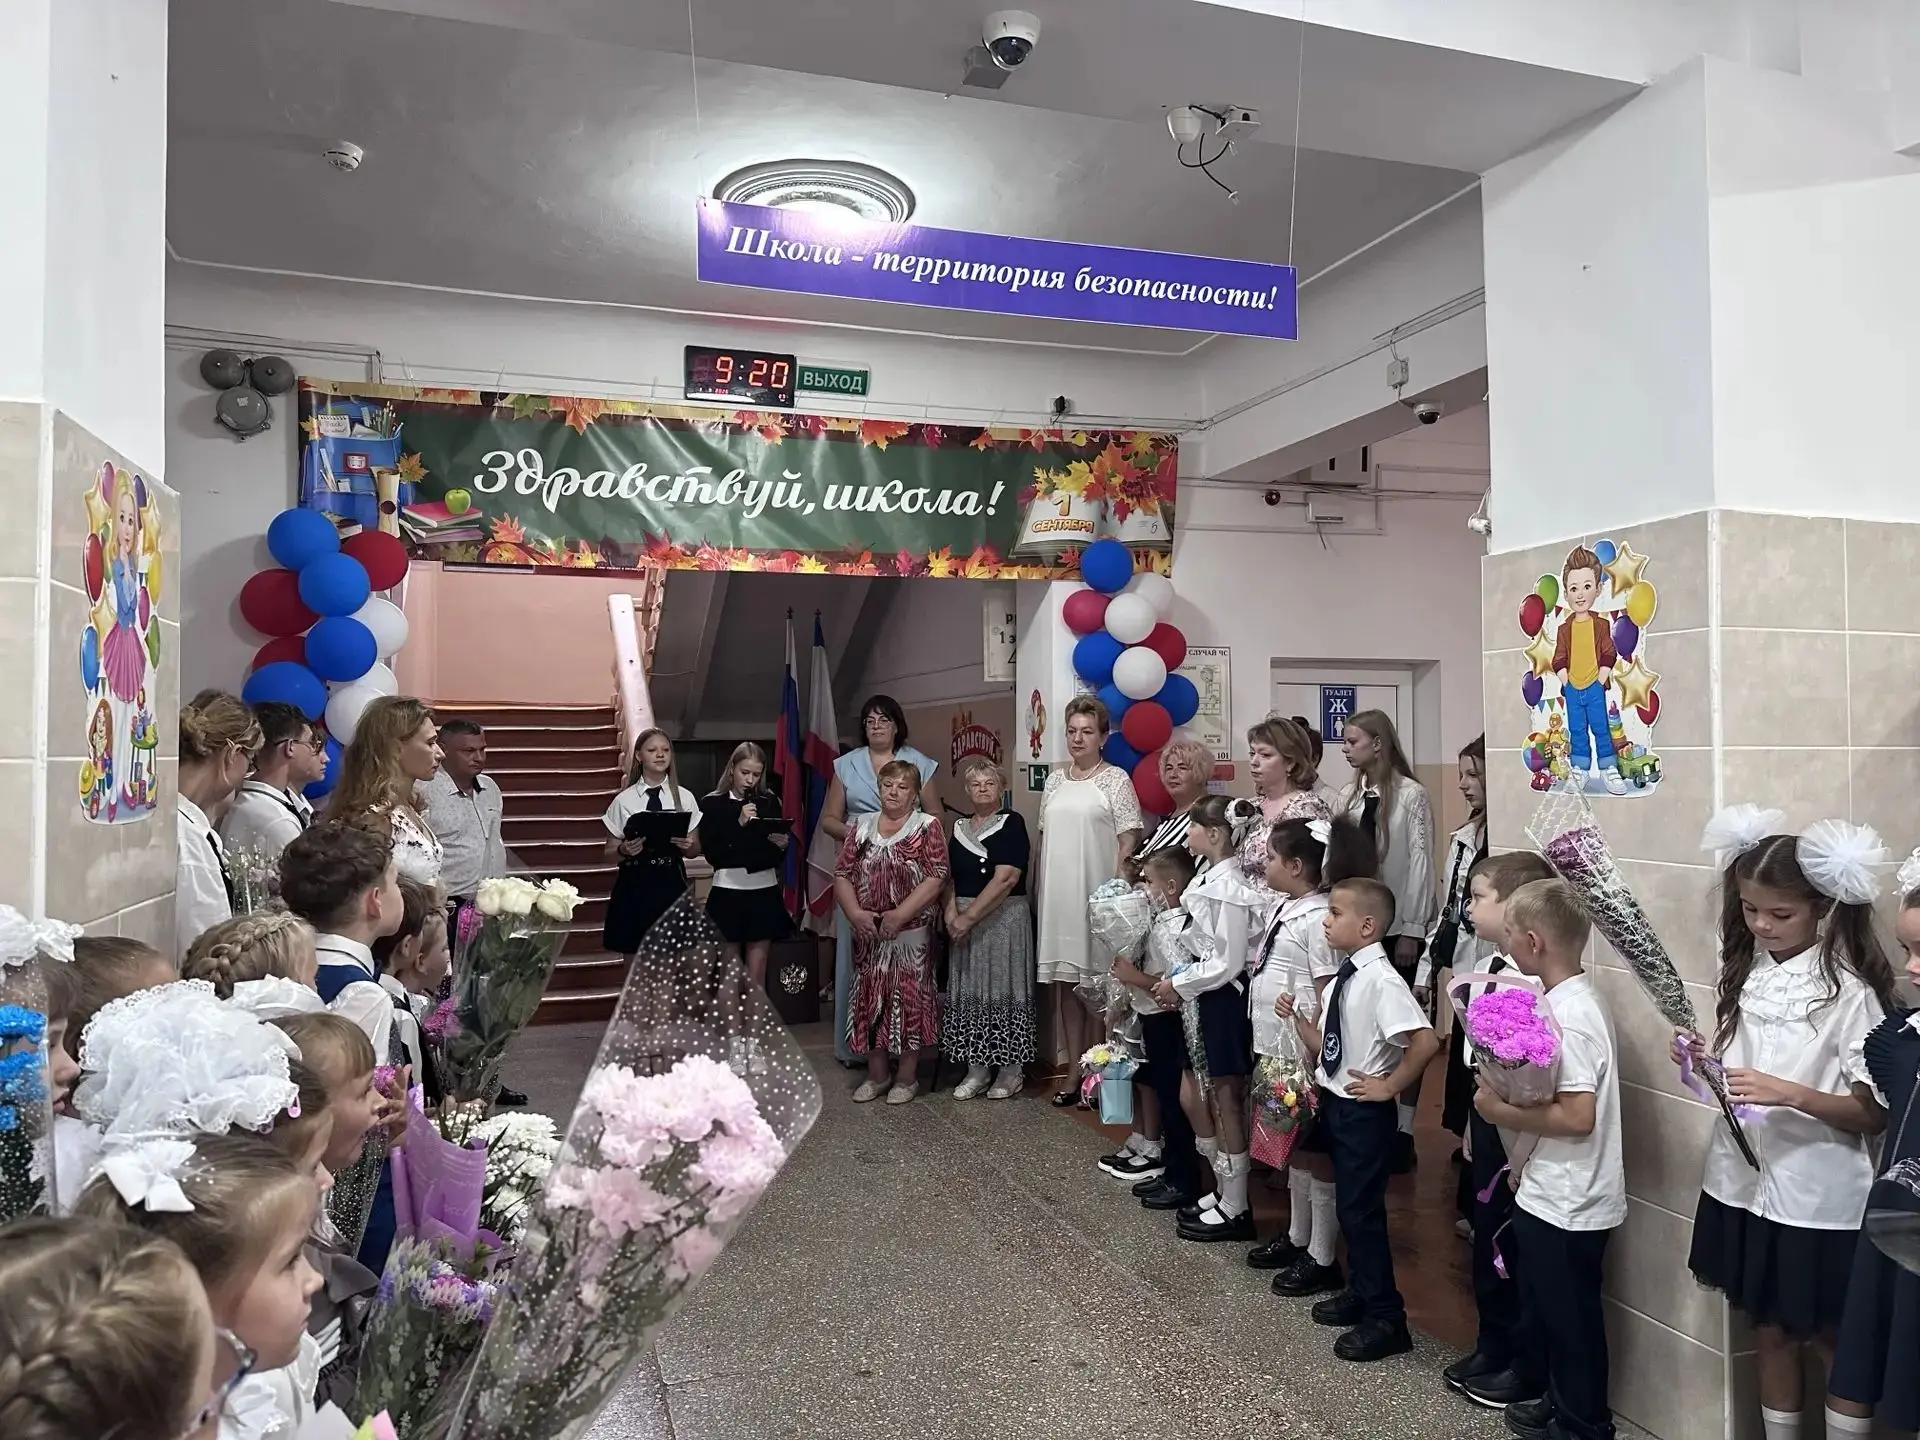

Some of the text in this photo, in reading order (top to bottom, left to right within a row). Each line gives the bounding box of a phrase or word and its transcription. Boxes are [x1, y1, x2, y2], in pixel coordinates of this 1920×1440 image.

[724, 226, 842, 265] Школа
[872, 250, 1065, 292] территория
[1075, 266, 1278, 310] безопасности!
[716, 356, 789, 389] 9:20
[803, 371, 863, 393] ВЫХОД
[473, 448, 1005, 519] Здравствуй, школа!
[1053, 494, 1071, 517] 1
[1032, 518, 1094, 534] СЕНТЯБРЯ
[1188, 648, 1217, 656] СЛУЧАЙ
[1325, 689, 1353, 697] ТУАЛЕТ
[1328, 698, 1349, 713] Ж
[1217, 752, 1229, 760] 101
